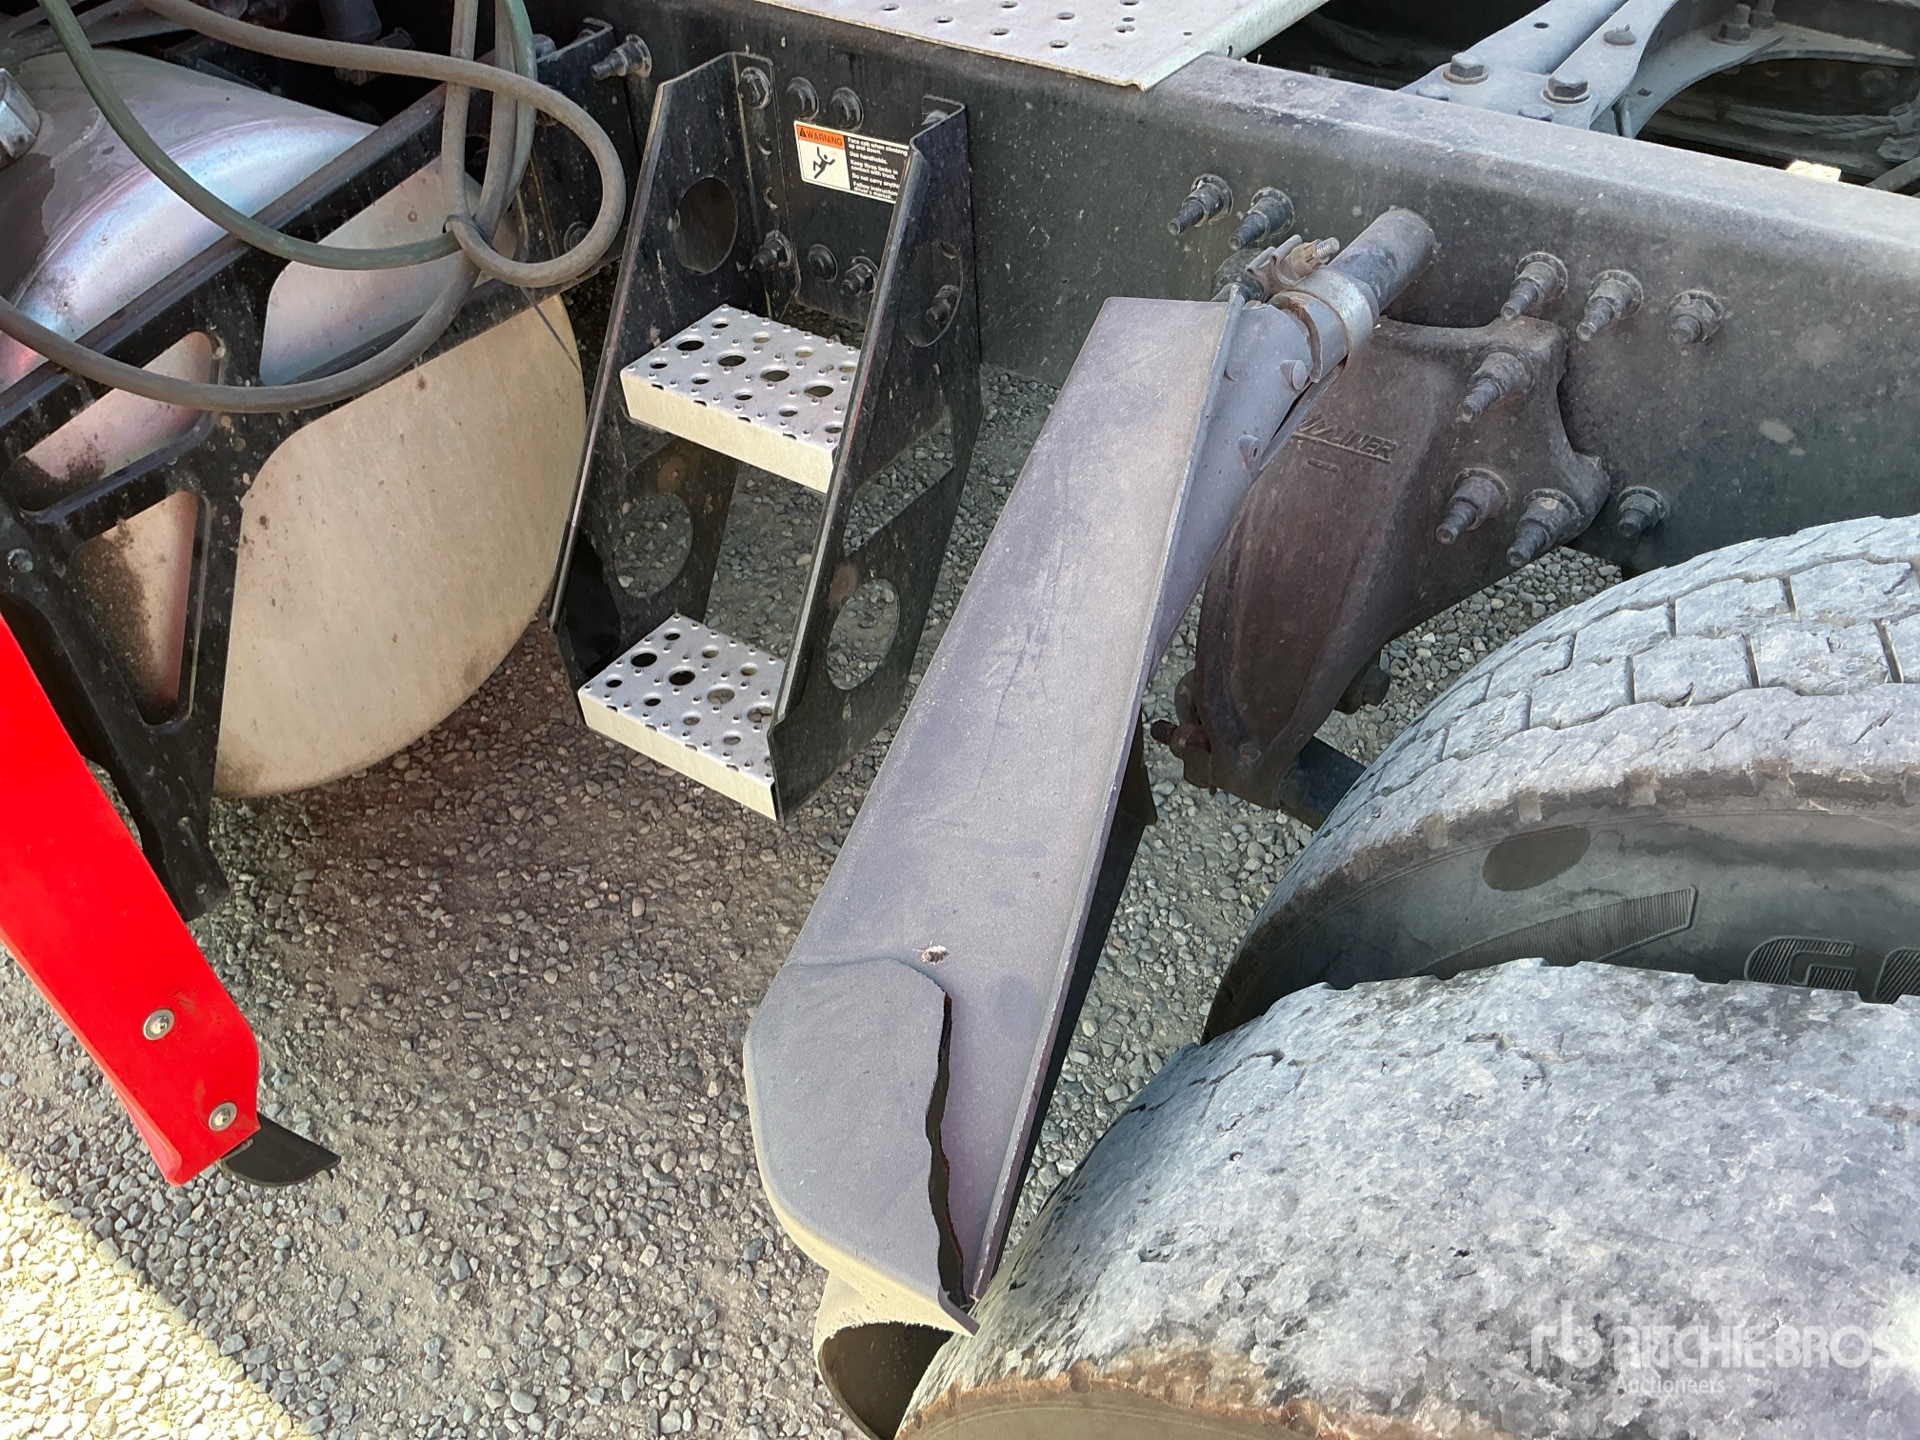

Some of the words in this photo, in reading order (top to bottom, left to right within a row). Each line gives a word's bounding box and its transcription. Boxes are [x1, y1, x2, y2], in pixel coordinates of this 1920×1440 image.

[806, 131, 843, 147] WARNING
[866, 147, 882, 155] down.
[870, 142, 884, 150] when
[885, 146, 907, 157] climbing
[850, 159, 863, 168] Keep
[864, 162, 877, 170] three
[850, 164, 869, 173] contact
[881, 172, 896, 180] truck.
[853, 180, 869, 189] Follow
[870, 185, 897, 196] instruction
[869, 177, 882, 185] carry
